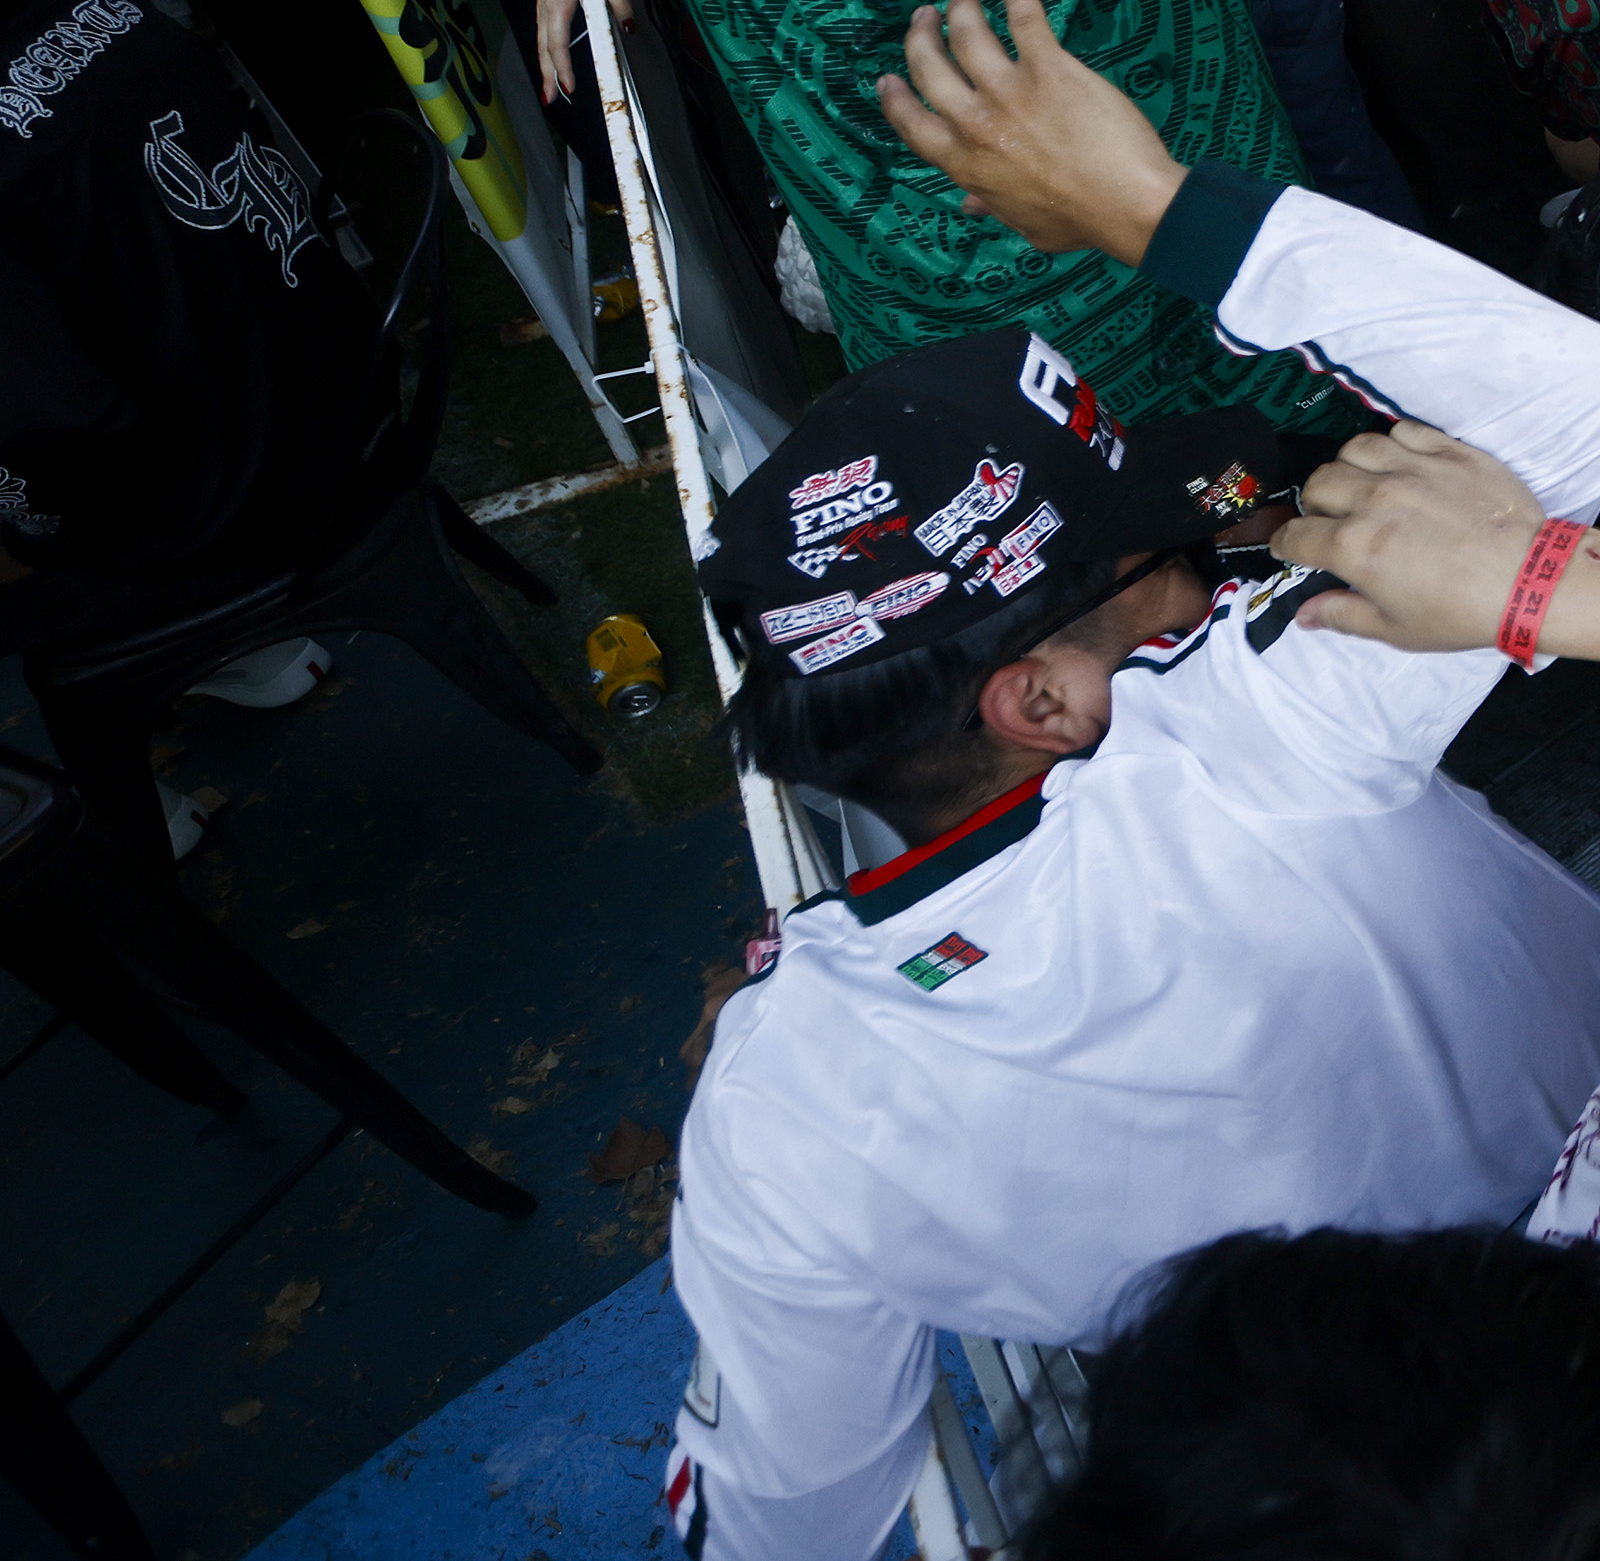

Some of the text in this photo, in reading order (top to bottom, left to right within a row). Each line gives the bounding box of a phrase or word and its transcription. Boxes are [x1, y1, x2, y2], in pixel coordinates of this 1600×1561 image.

[1186, 476, 1205, 490] FINO
[790, 481, 894, 545] FINO
[917, 513, 949, 539] MADE
[955, 479, 988, 511] JAPAN
[1018, 515, 1051, 548] FINO
[951, 534, 988, 569] FINO
[870, 580, 932, 613] FINO
